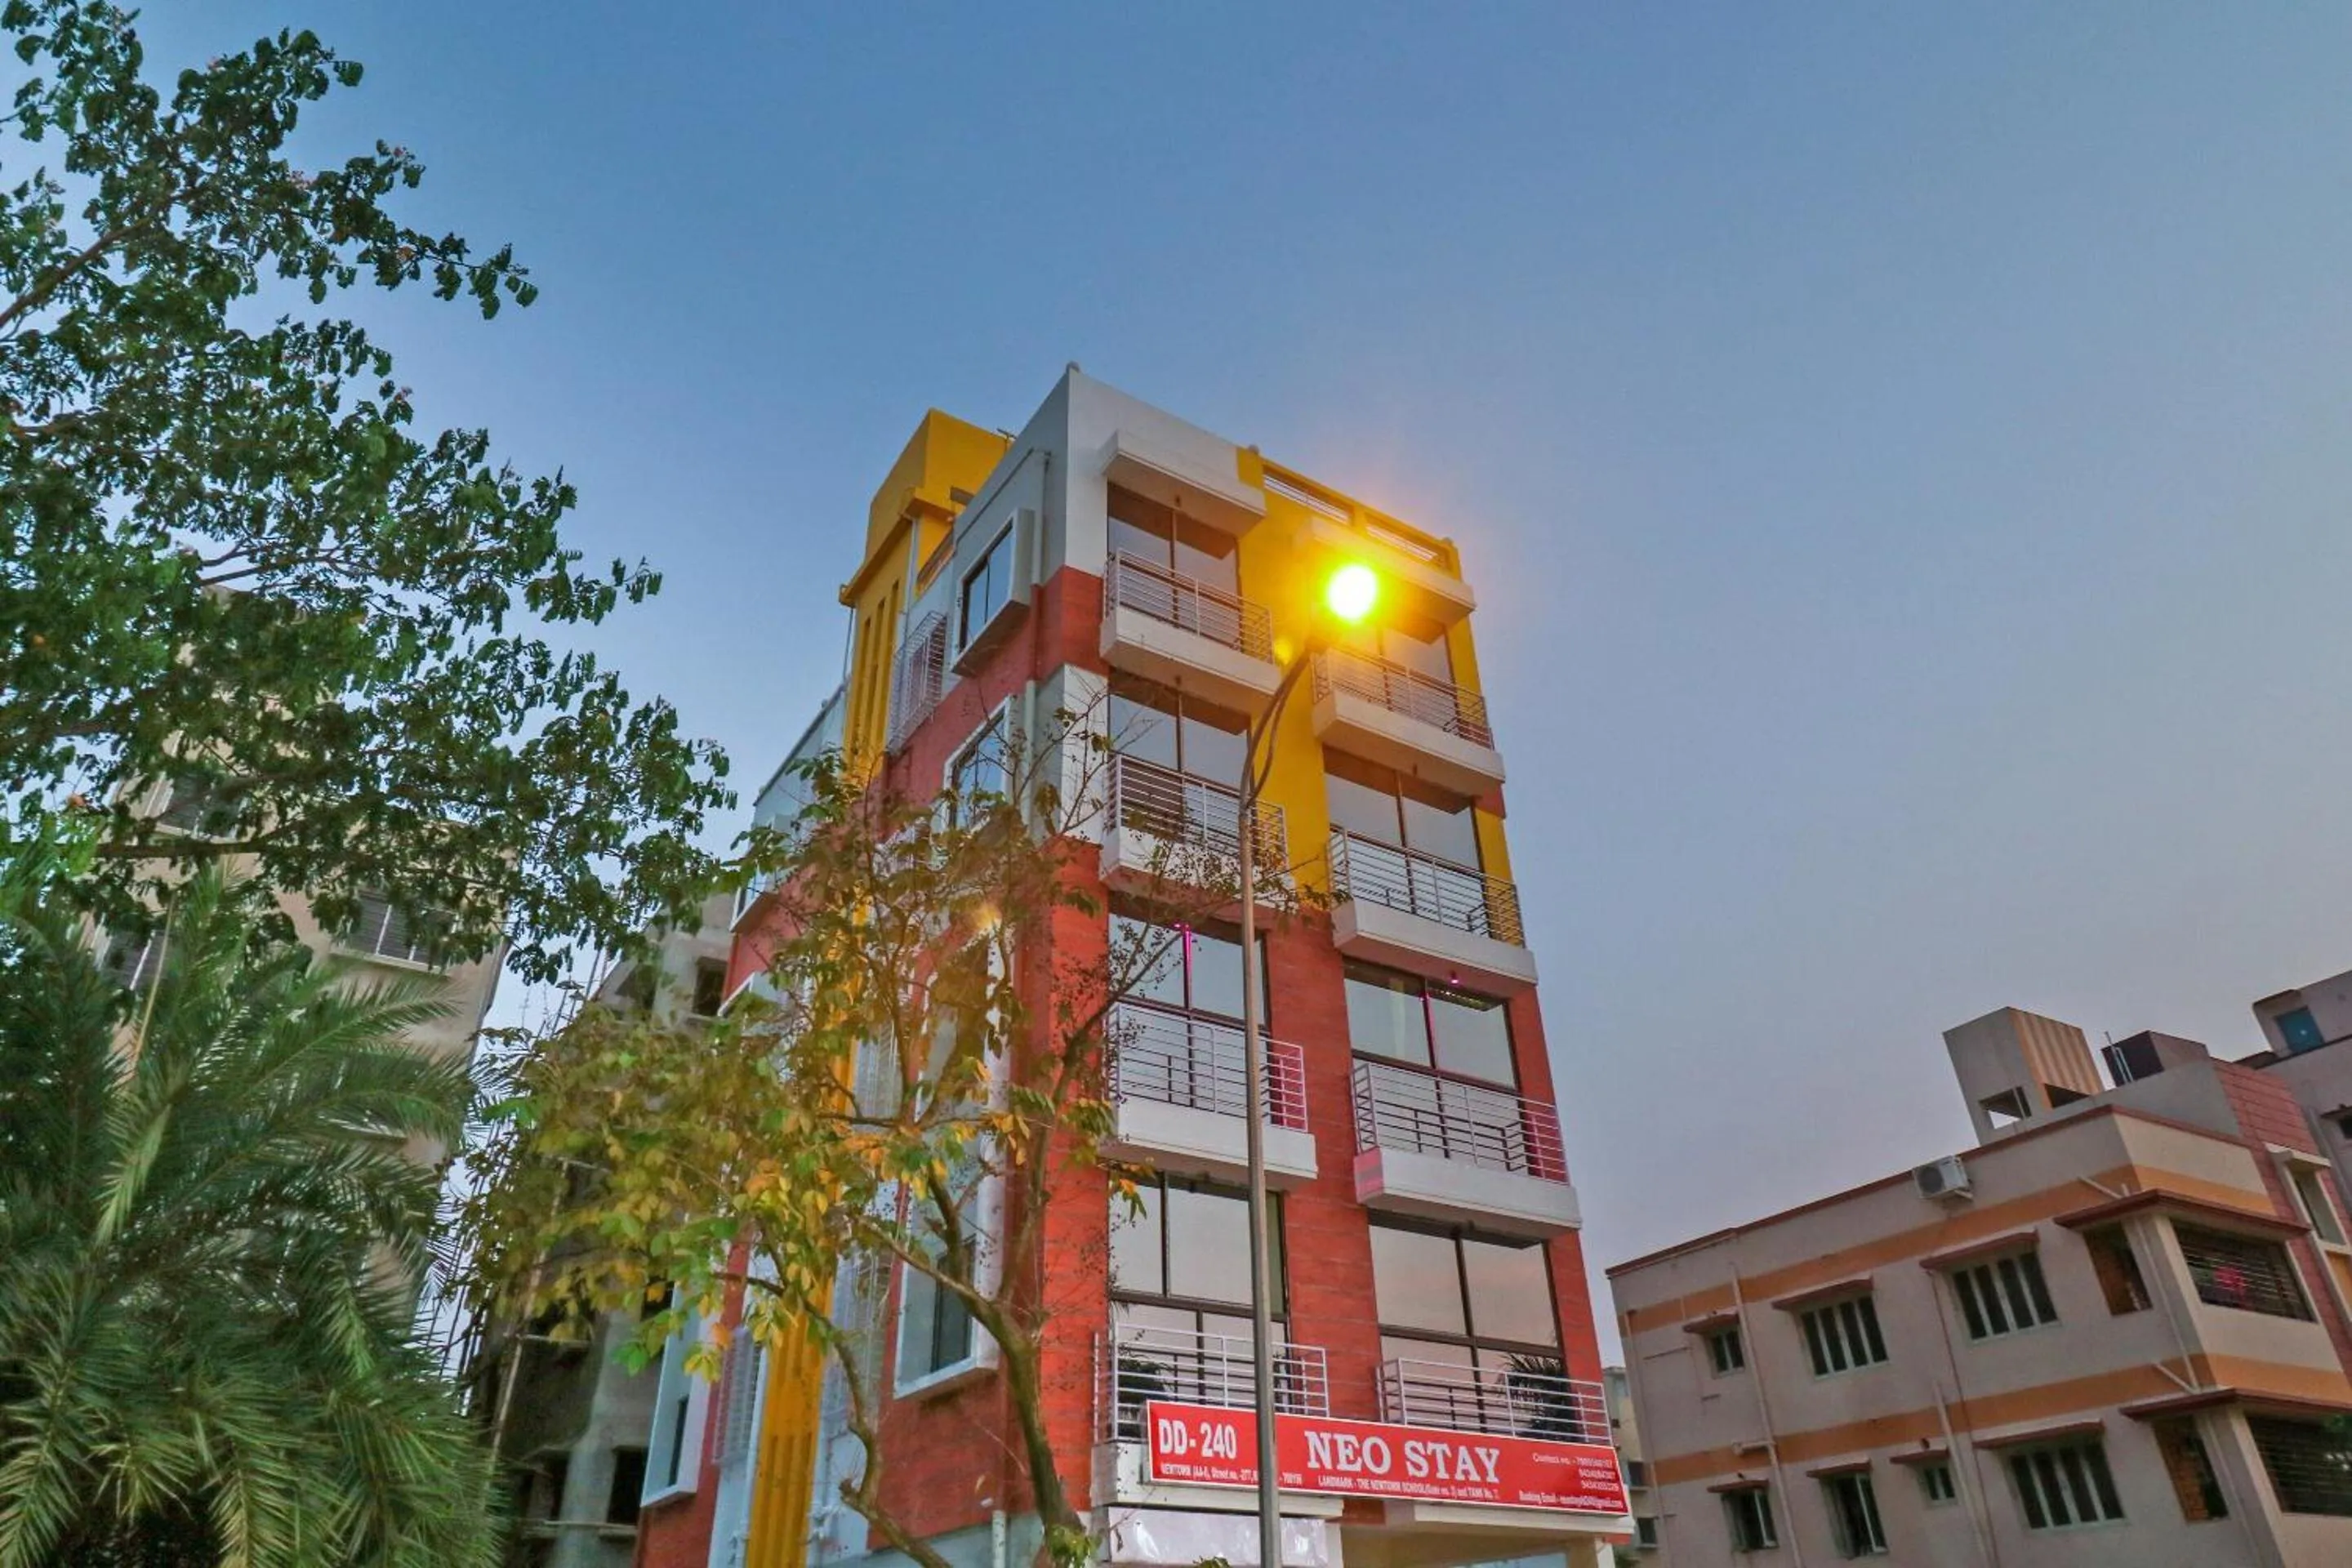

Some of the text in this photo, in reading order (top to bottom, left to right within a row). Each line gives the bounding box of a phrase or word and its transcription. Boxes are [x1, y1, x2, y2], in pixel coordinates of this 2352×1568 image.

[1158, 1419, 1237, 1459] DD- 240
[1304, 1430, 1499, 1484] NEO STAY
